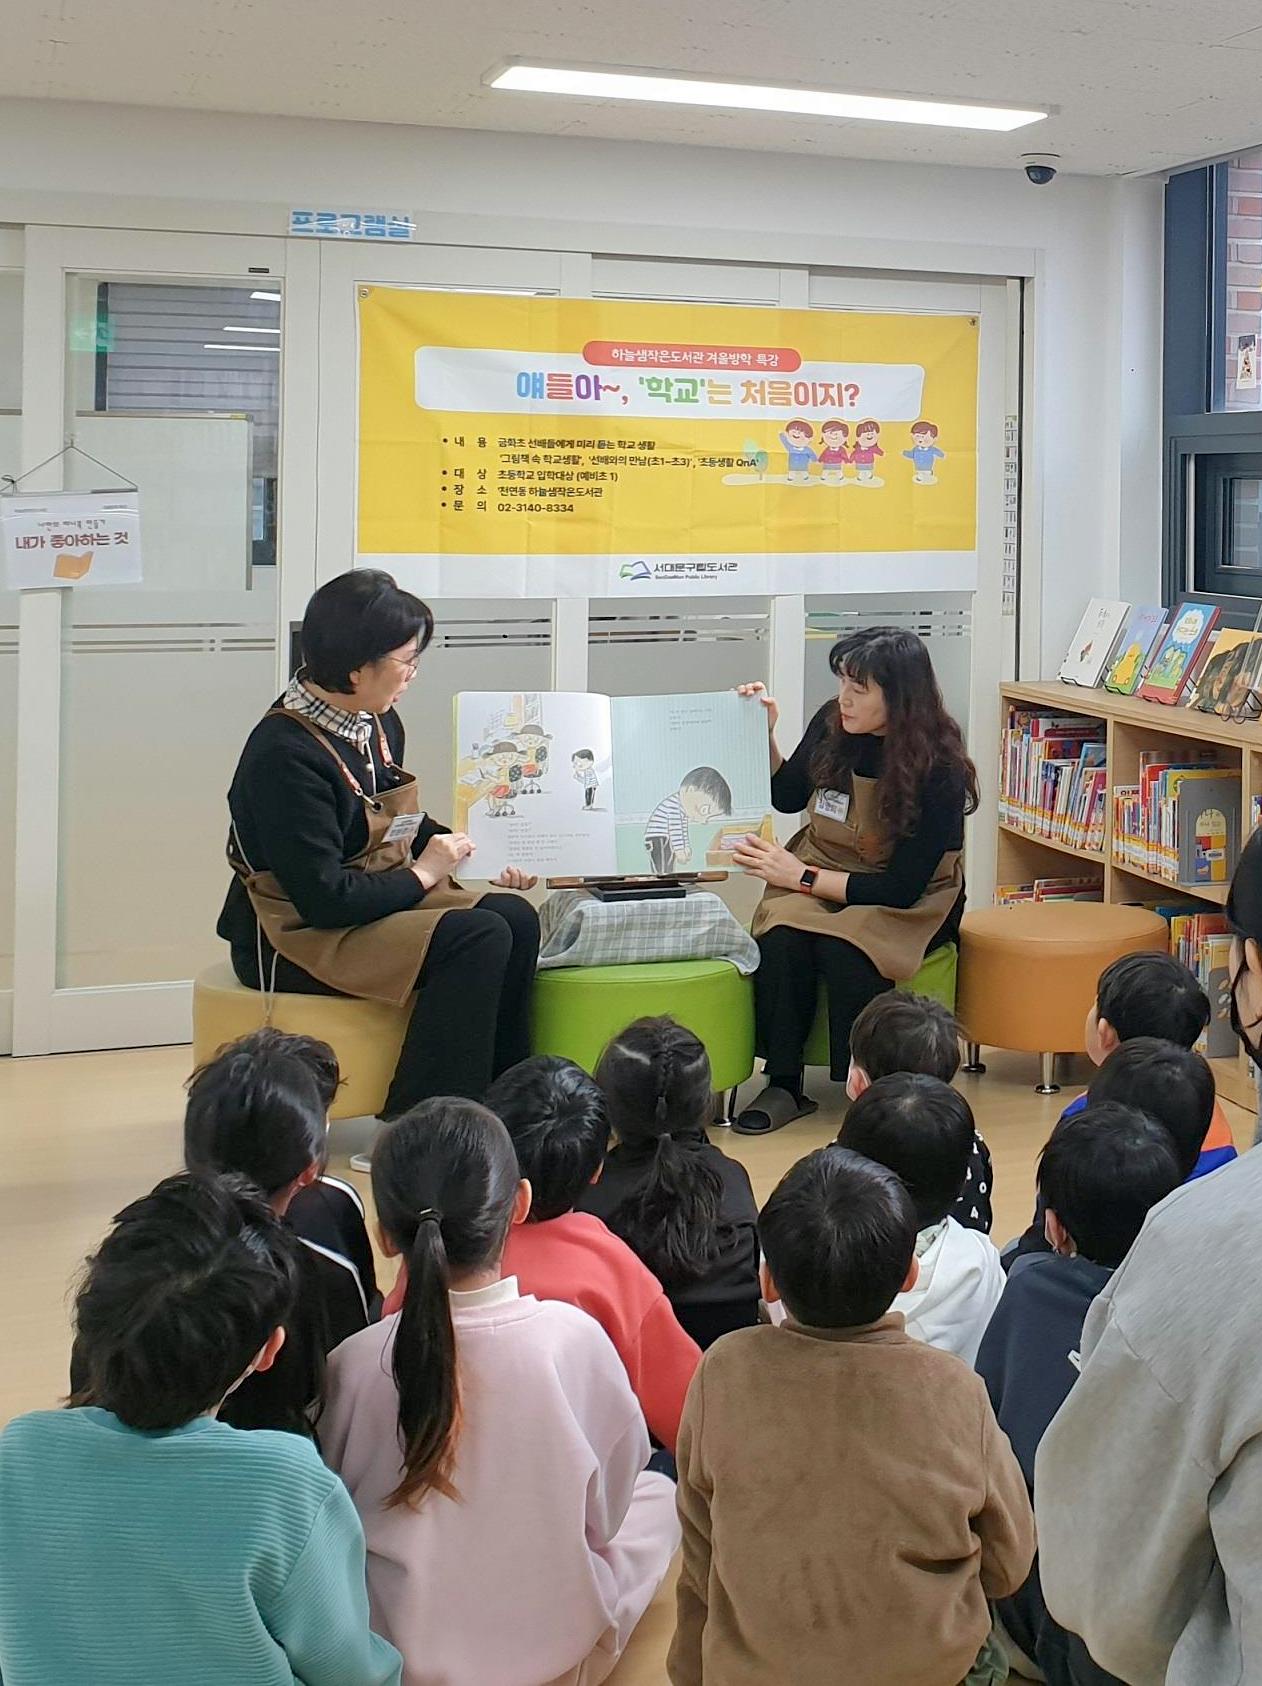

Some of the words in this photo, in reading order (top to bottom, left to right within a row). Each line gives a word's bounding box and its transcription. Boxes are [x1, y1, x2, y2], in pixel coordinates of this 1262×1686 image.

[291, 211, 410, 238] 프로그램실
[611, 347, 704, 364] 하늘샘작은도서관
[706, 351, 752, 366] 겨울방학
[755, 352, 780, 367] 특강
[516, 371, 629, 406] 얘들아~,
[638, 376, 733, 405] '학교'는
[740, 380, 860, 408] 처음이지?
[528, 438, 575, 449] 선배들에게
[576, 439, 595, 449] 미리
[617, 440, 636, 450] 학교
[637, 440, 656, 451] 생활
[531, 454, 543, 464] 속
[454, 468, 464, 479] 대
[477, 468, 487, 480] 상
[498, 470, 535, 481] 초등학교
[536, 470, 574, 481] 입학대상
[453, 484, 464, 496] 장
[477, 484, 487, 495] 소
[528, 487, 603, 498] 하늘샘작은도서관
[453, 501, 464, 512] 문
[477, 500, 487, 512] 의
[497, 503, 574, 513] 02-3140-8334
[15, 536, 46, 549] 내가
[50, 533, 111, 549] 좋아하는
[114, 531, 129, 545] 것
[653, 562, 738, 573] 서대문구립도서관
